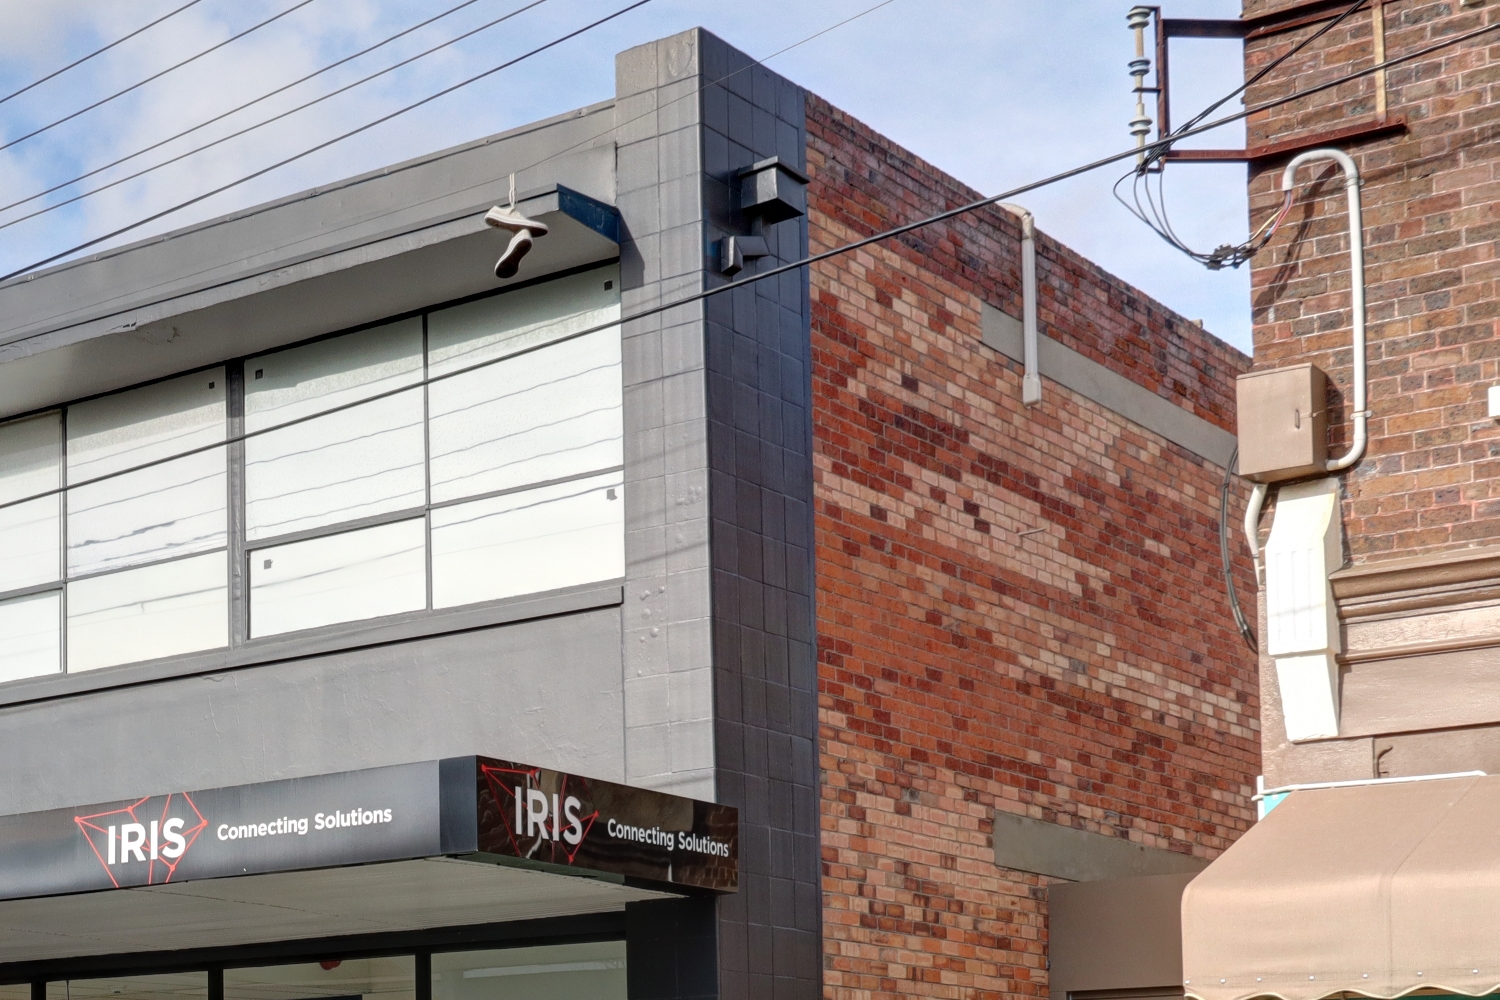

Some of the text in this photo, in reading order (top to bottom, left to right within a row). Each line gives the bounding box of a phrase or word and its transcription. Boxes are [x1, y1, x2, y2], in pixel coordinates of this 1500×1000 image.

[107, 807, 393, 865] IRIS Connecting Solutions
[515, 785, 729, 858] IRIS Connecting Solutions
